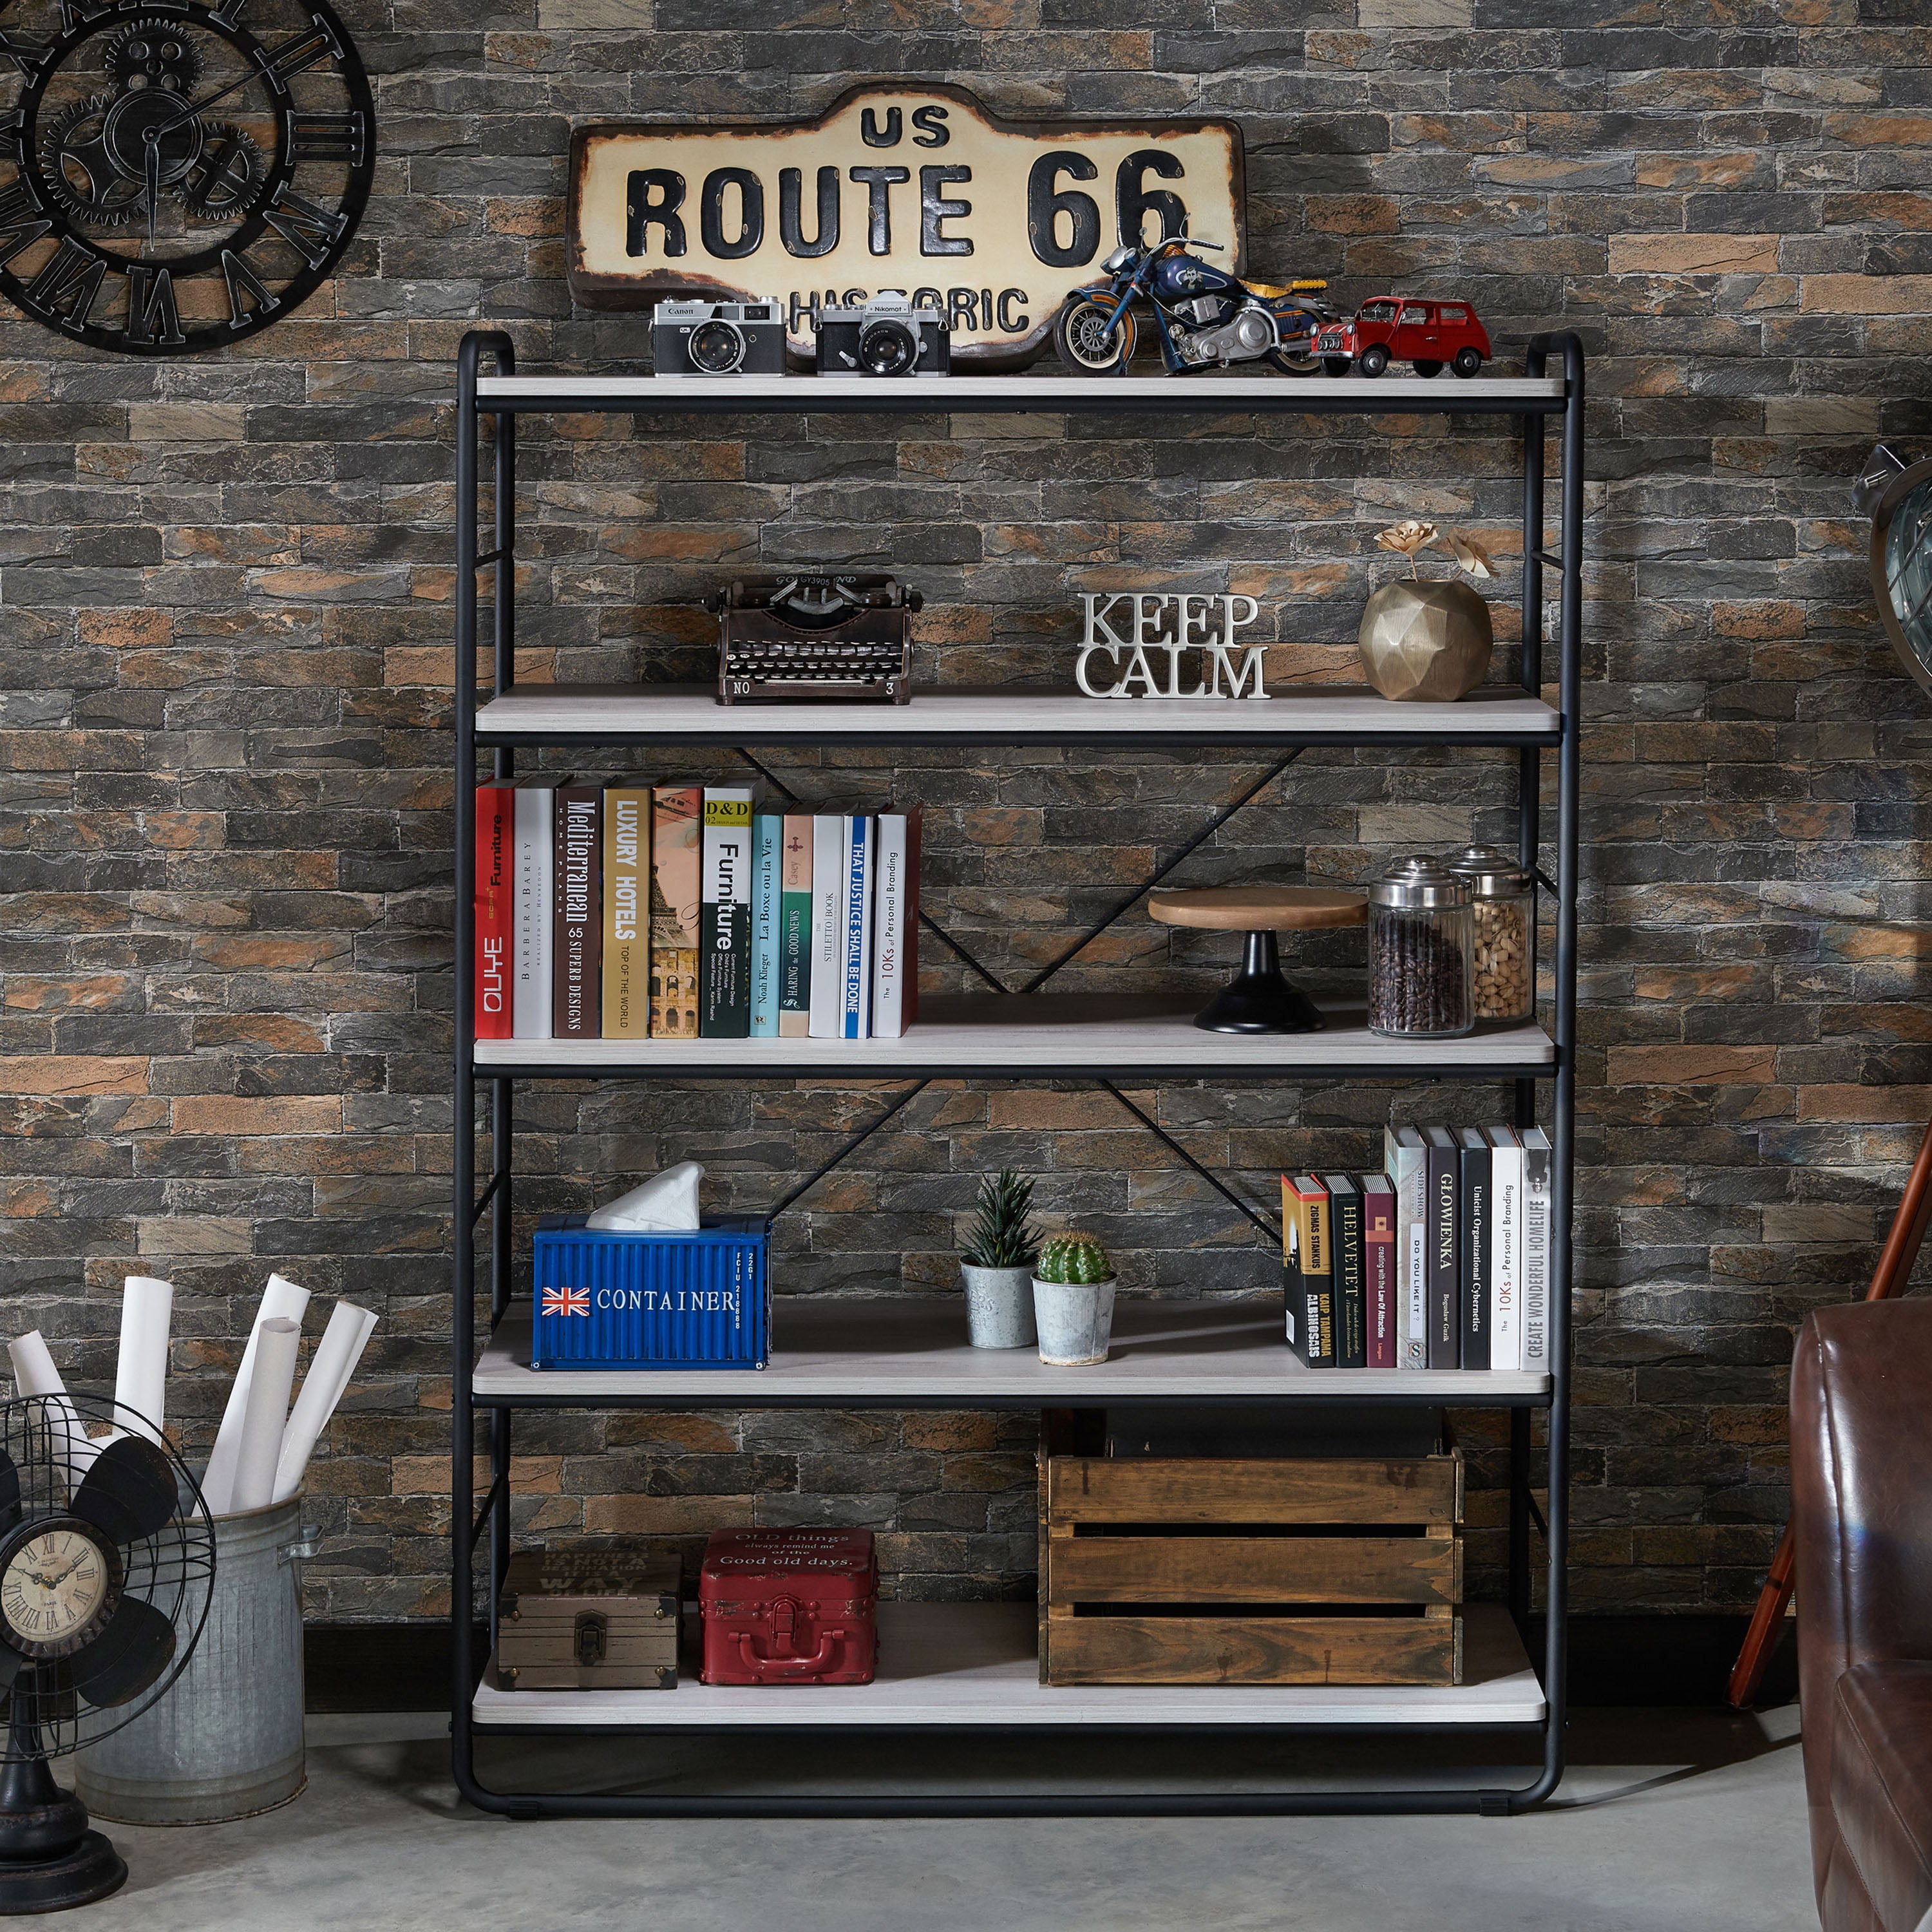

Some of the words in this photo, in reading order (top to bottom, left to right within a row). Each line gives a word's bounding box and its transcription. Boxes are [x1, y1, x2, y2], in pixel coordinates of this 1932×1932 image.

[860, 105, 951, 149] US
[625, 164, 974, 260] ROUTE
[1028, 149, 1189, 267] 66
[790, 287, 1029, 334] HRIC
[1077, 592, 1258, 648] KEEP
[1076, 646, 1272, 699] CALM
[733, 683, 750, 695] NO
[616, 800, 638, 867] LUXURY
[762, 837, 772, 858] Vie
[490, 814, 502, 886] Furniture
[566, 800, 596, 923] Mediterranean
[852, 842, 864, 874] THAT
[761, 861, 772, 871] la
[788, 861, 800, 886] Casey
[886, 852, 898, 892] Branding
[716, 844, 739, 951] Furniture
[764, 875, 771, 890] ou
[615, 876, 637, 940] HOTELS
[759, 893, 770, 922] Boxe
[825, 893, 833, 917] BOOK
[850, 876, 863, 926] JUSTICE
[885, 896, 895, 937] Personal
[568, 927, 583, 938] 65
[759, 925, 769, 941] La
[789, 909, 800, 932] NEWS
[621, 946, 629, 962] TOP
[788, 933, 800, 955] GOOD
[824, 922, 833, 962] STILETTO
[849, 929, 861, 964] SHALL
[568, 941, 582, 981] SUPERB
[621, 964, 629, 976] OF
[759, 953, 771, 981] Klieger
[848, 966, 860, 979] BE
[882, 948, 895, 979] 10Ks
[620, 978, 629, 994] THE
[758, 982, 768, 1004] Noah
[847, 982, 859, 1013] DONE
[567, 985, 581, 1030] DESIGNS
[620, 996, 629, 1028] WORLD
[1473, 1186, 1482, 1216] Unicist
[1502, 1185, 1514, 1225] Branding
[1310, 1205, 1320, 1233] ZIGMAS
[1529, 1200, 1545, 1251] HOMELIFE
[1311, 1235, 1321, 1269] STANKUS
[1343, 1206, 1358, 1297] HELVETET
[1377, 1246, 1385, 1268] creating
[1414, 1240, 1420, 1254] DO
[1472, 1218, 1482, 1280] Organizational
[1502, 1229, 1511, 1270] Personal
[597, 1289, 735, 1311] CONTAINER
[1499, 1281, 1511, 1311] 10Ks
[1528, 1255, 1544, 1319] WONDERFUL
[1320, 1293, 1330, 1314] KAIP
[1413, 1304, 1419, 1313] IT
[1472, 1282, 1481, 1332] Cybernetics
[1307, 1294, 1320, 1358] ALBINOSAIS
[1320, 1316, 1331, 1357] TAMPAMA
[1527, 1321, 1544, 1358] CREATE
[788, 1535, 849, 1543] things
[720, 1556, 766, 1565] Good
[808, 1557, 853, 1567] days.
[540, 1577, 644, 1589] WAY
